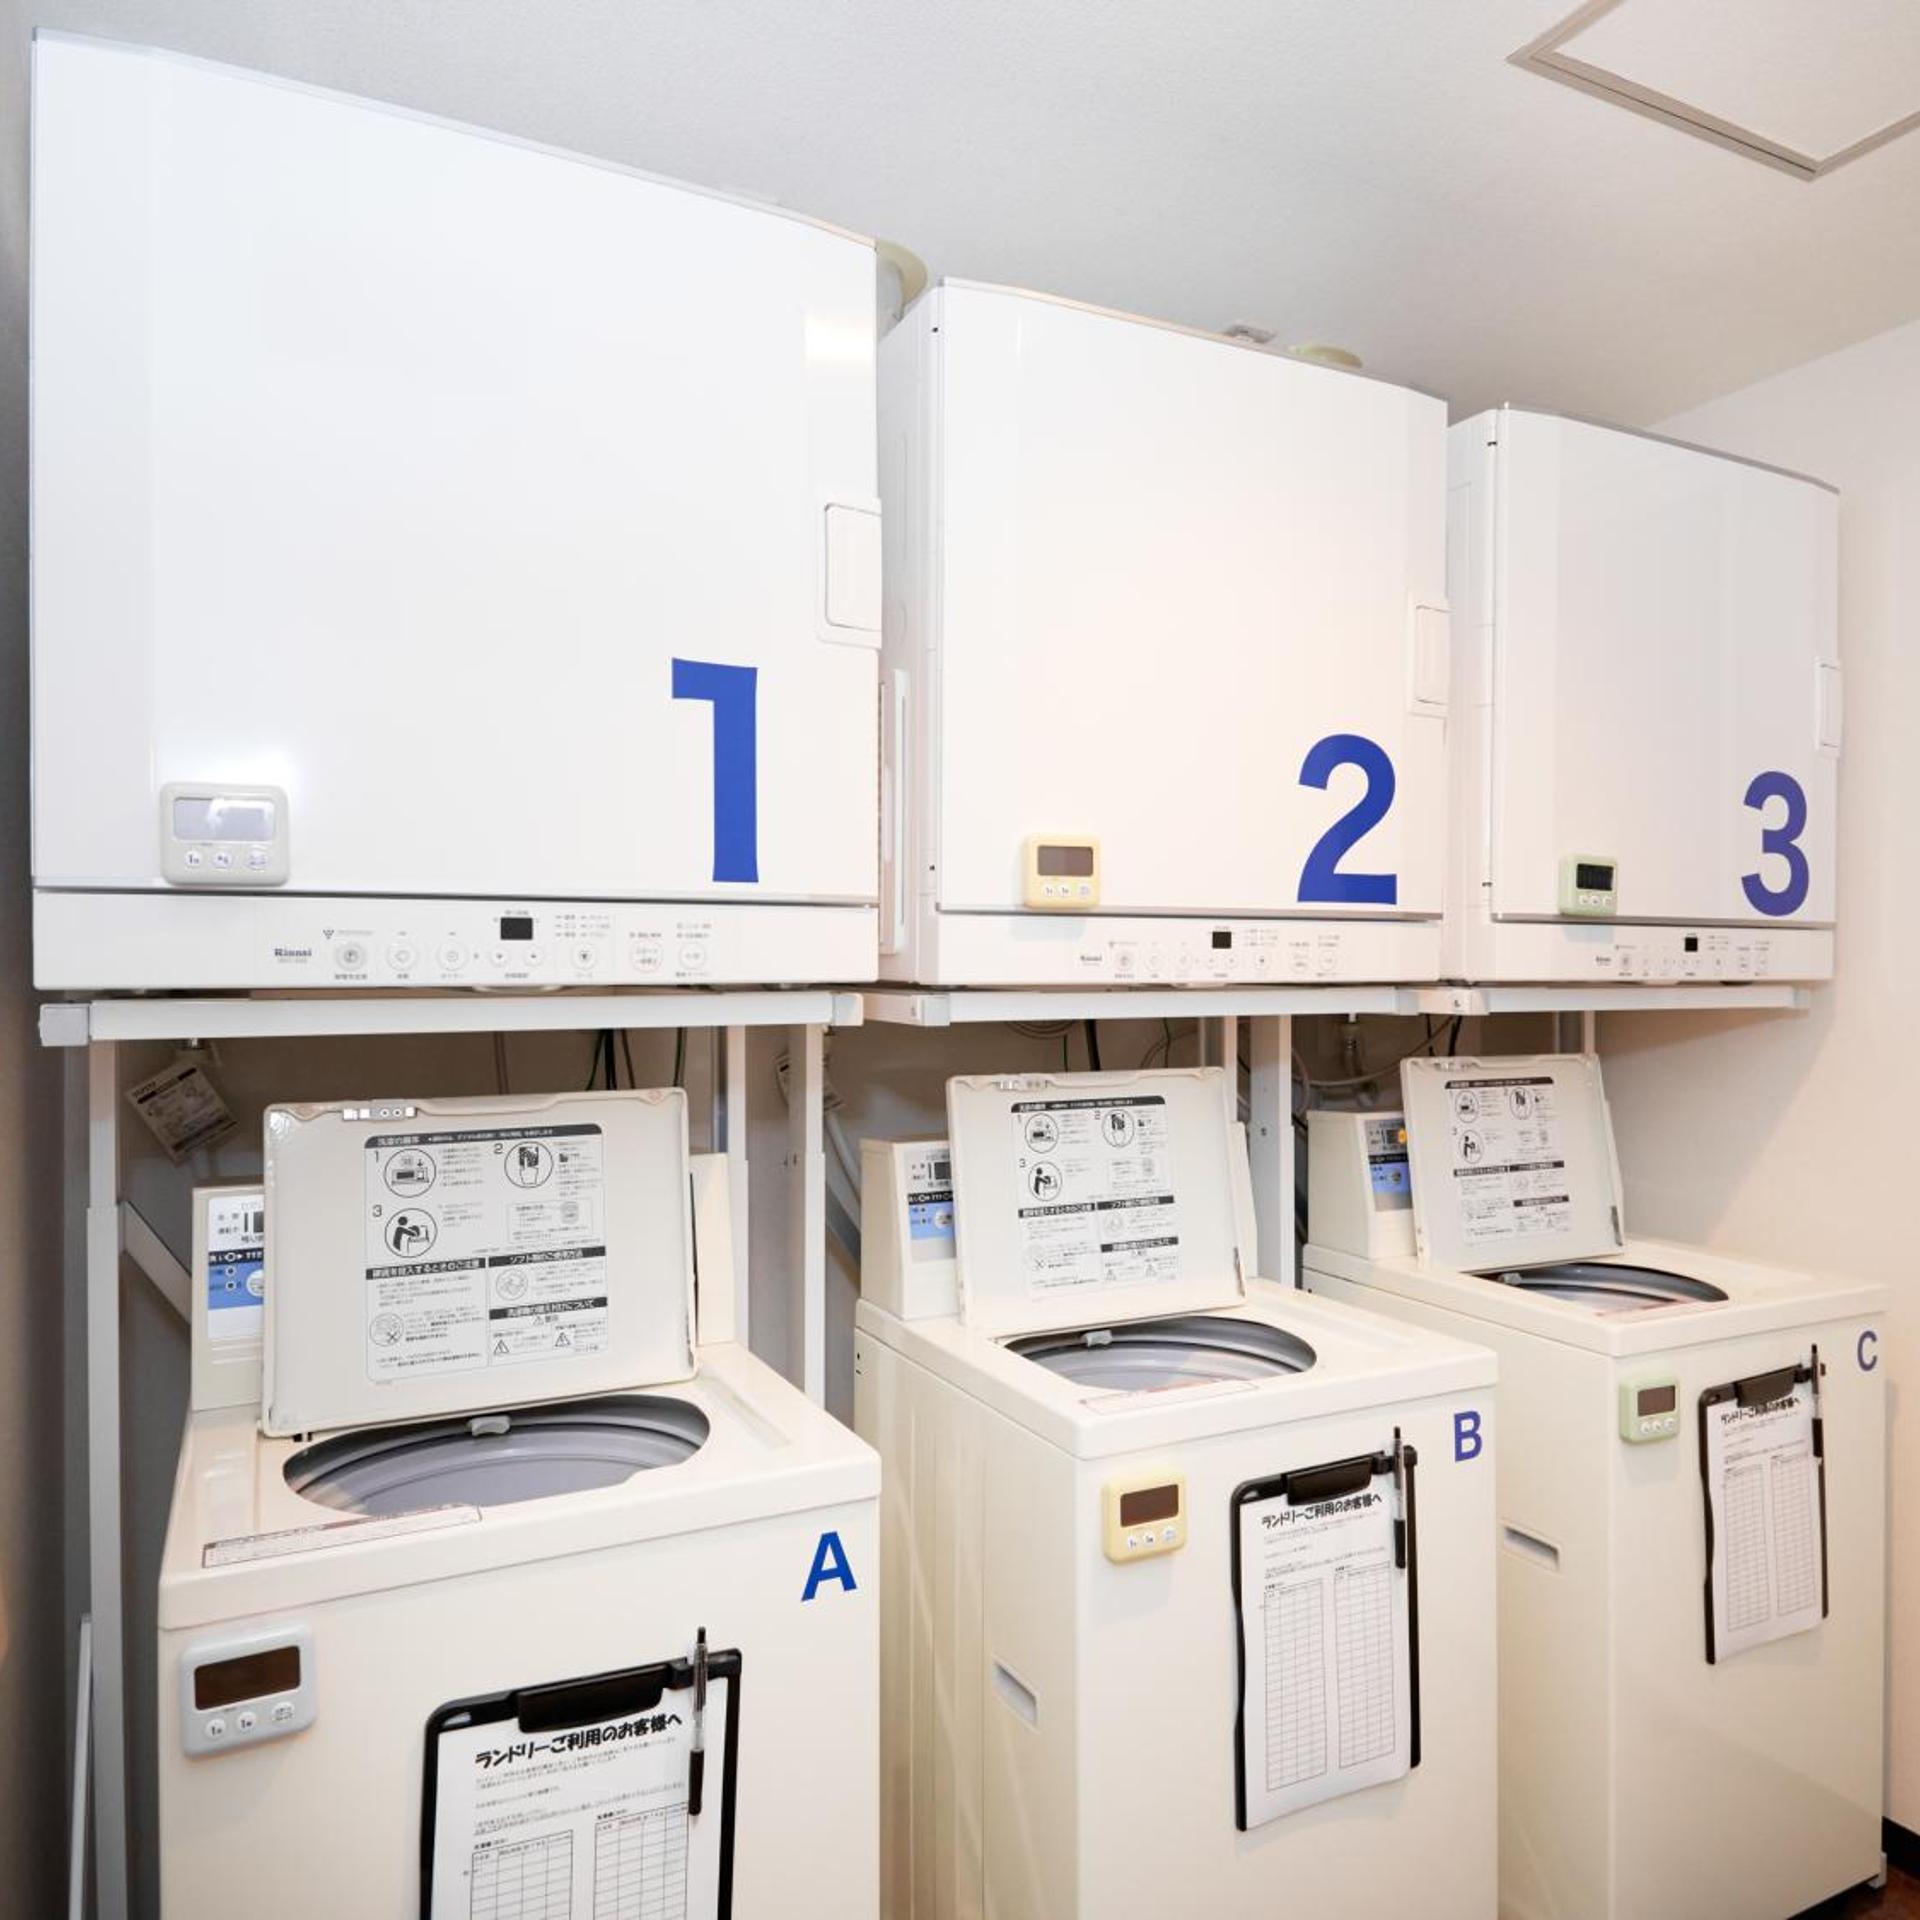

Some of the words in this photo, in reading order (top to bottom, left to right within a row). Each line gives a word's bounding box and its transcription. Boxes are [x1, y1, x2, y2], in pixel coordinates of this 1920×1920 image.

[672, 658, 758, 882] 1
[1298, 734, 1396, 905] 2
[1742, 772, 1809, 916] 3
[274, 947, 312, 957] Rinnai
[494, 1143, 503, 1154] 2
[372, 1204, 382, 1218] 3
[1858, 1331, 1877, 1371] C
[1455, 1411, 1481, 1461] B
[1262, 1493, 1383, 1529] ランドリーご利用のお客様へ
[802, 1532, 856, 1601] A
[474, 1713, 683, 1769] ランドリーご利用のお客様へ
